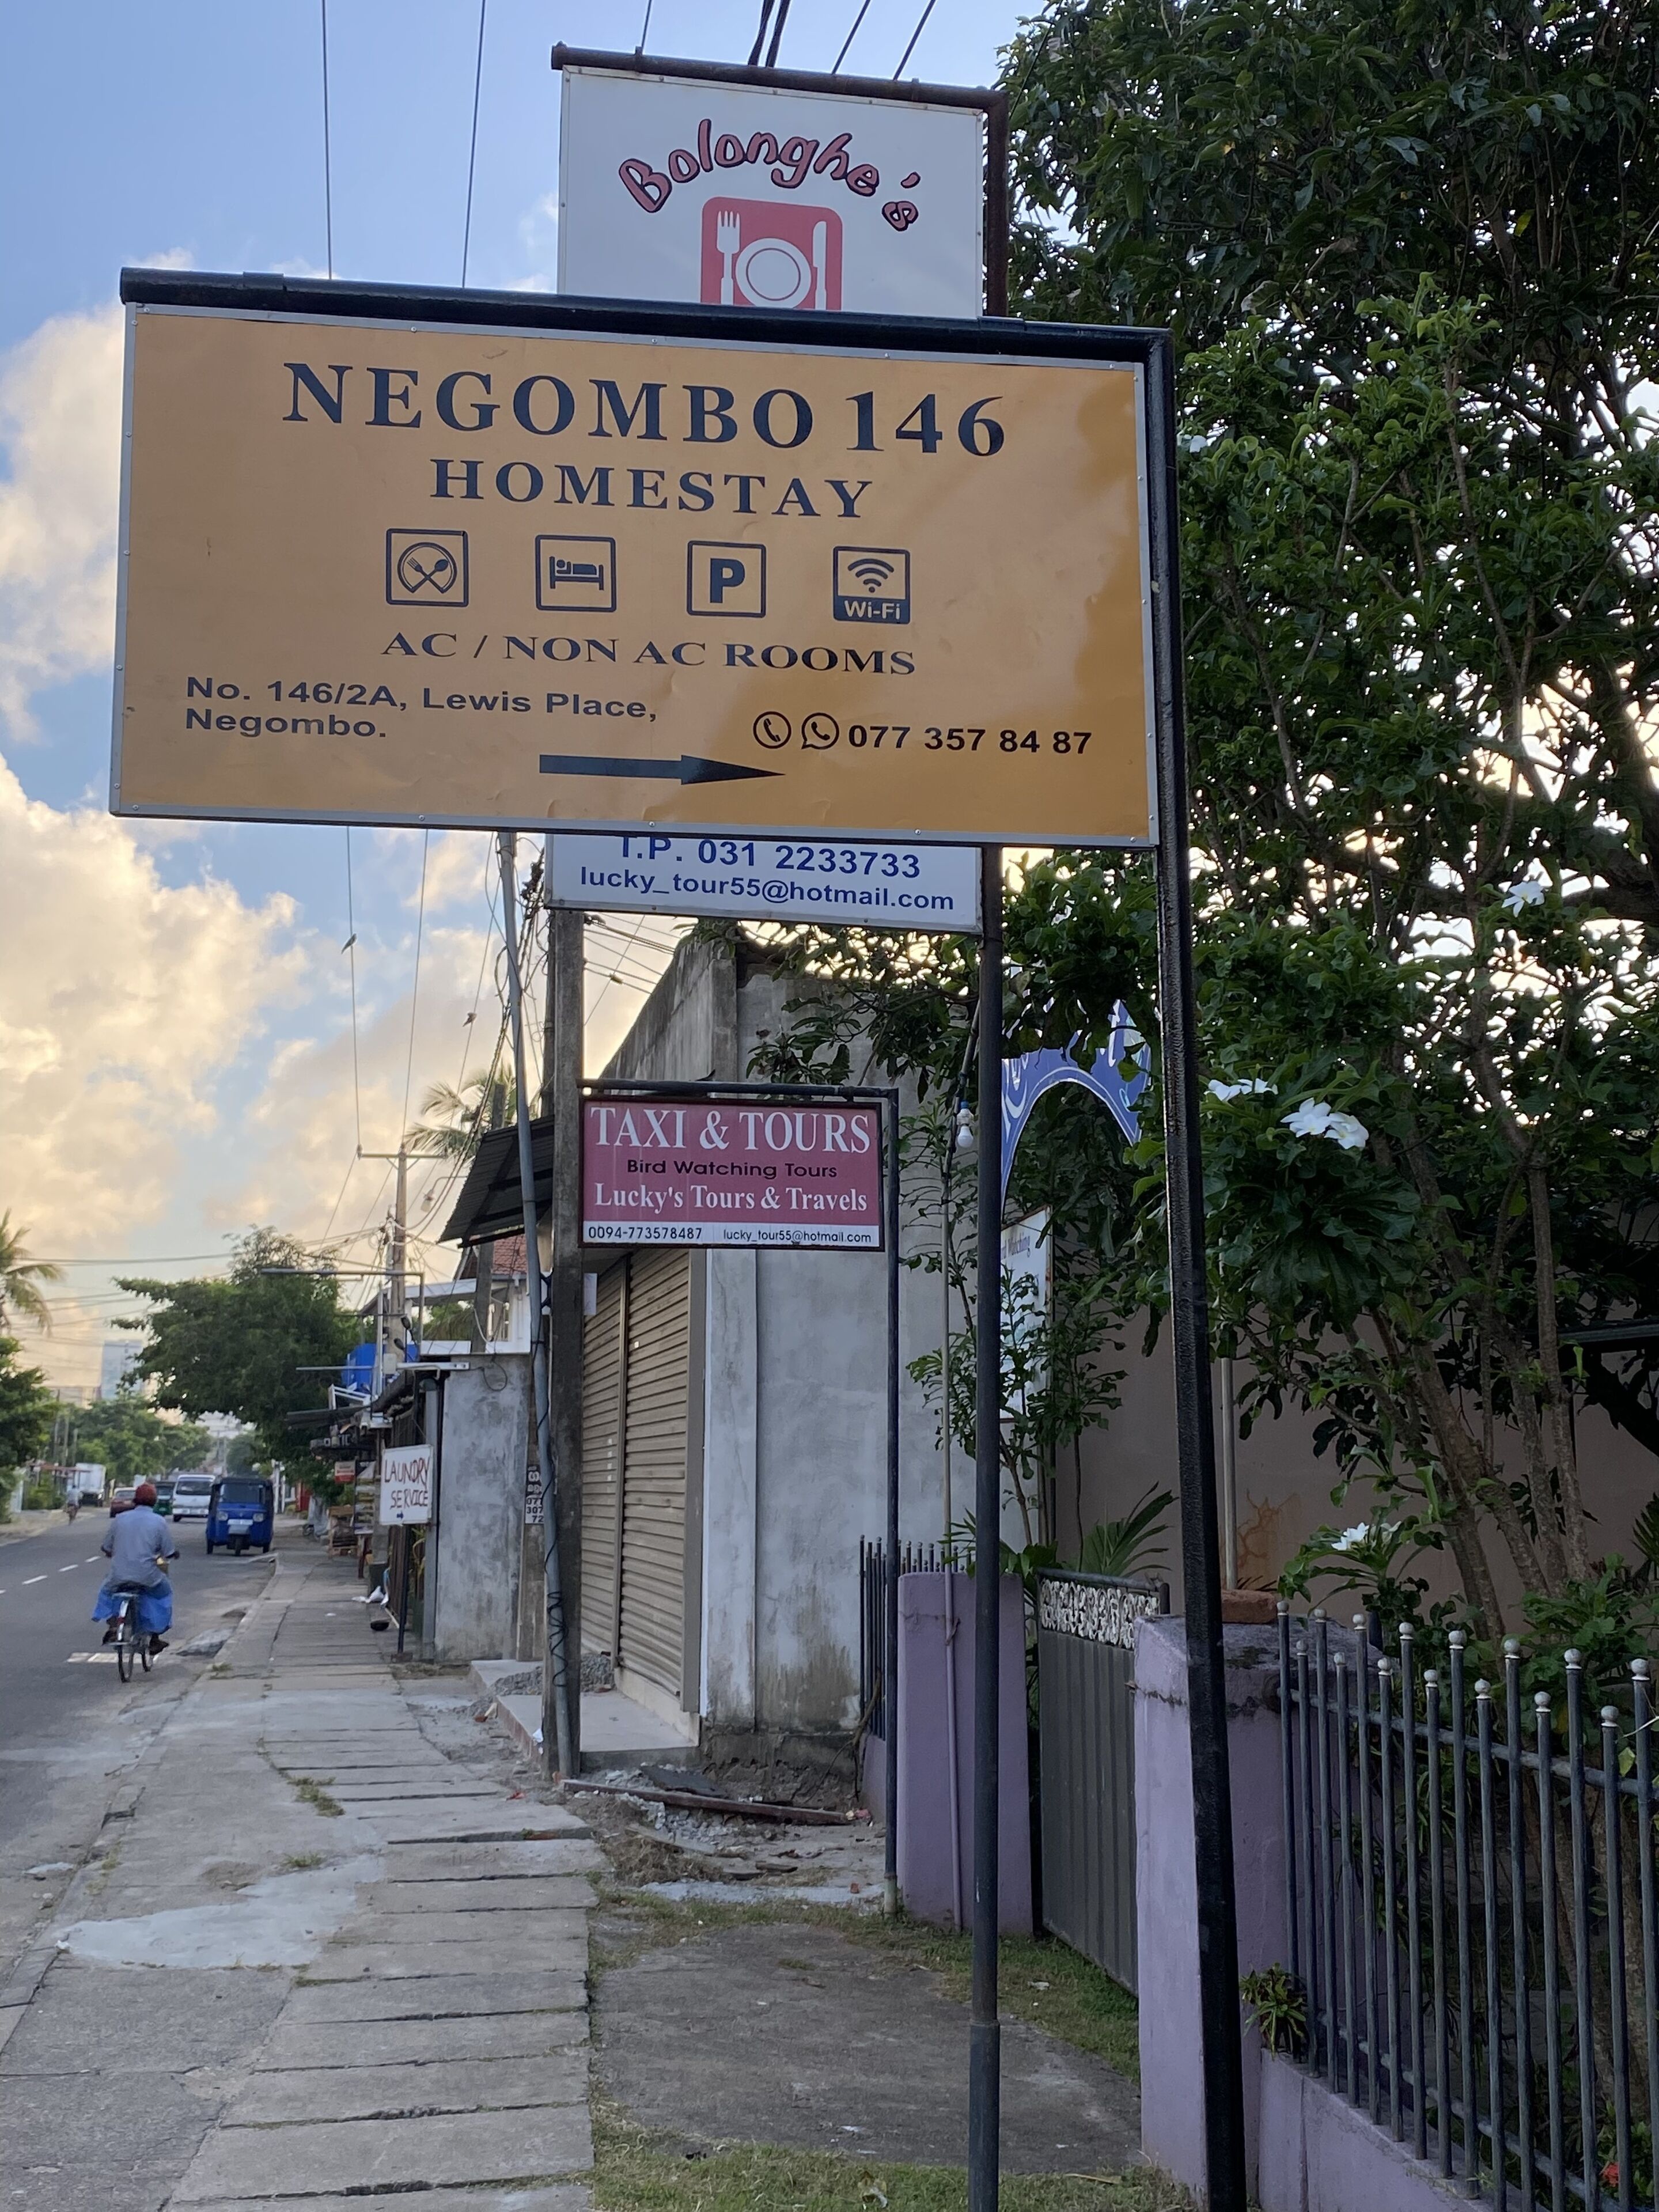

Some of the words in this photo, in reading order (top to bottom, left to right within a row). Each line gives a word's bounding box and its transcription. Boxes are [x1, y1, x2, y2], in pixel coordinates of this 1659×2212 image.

[619, 119, 921, 232] Bolonghe's
[282, 362, 813, 449] NEGOMBO
[845, 390, 1005, 456] 146
[430, 459, 873, 518] HOMESTAY
[710, 558, 745, 604] P
[844, 600, 900, 620] Wi-Fi
[380, 631, 457, 658] AC
[502, 635, 620, 663] NON
[632, 640, 707, 667] AC
[722, 643, 915, 675] ROOMS
[186, 676, 251, 702] No.
[267, 680, 407, 712] 146/2A,
[423, 687, 531, 714] Lewis
[546, 692, 657, 724] Place,
[185, 707, 387, 738] Negombo.
[848, 724, 911, 749] 077
[924, 726, 986, 752] 357
[998, 729, 1040, 753] 84
[1052, 730, 1093, 755] 87
[698, 839, 755, 866] 031
[775, 844, 921, 878] 2233733
[580, 866, 954, 910] lucky_tour55@hotmail.com
[590, 1107, 688, 1149] TAXI
[699, 1109, 730, 1150] &
[738, 1111, 871, 1154] TOURS
[627, 1159, 666, 1174] Bird
[673, 1160, 777, 1180] Watching
[784, 1163, 838, 1178] Tours
[594, 1183, 684, 1214] Lucky's
[690, 1185, 755, 1209] Tours
[760, 1186, 781, 1210] &
[785, 1187, 868, 1211] Travels
[588, 1226, 702, 1240] 0094-773578487
[723, 1229, 872, 1243] lucky_tour55@hotmail.com
[384, 1456, 430, 1491] LAUNDRY
[389, 1488, 429, 1510] SERVICE
